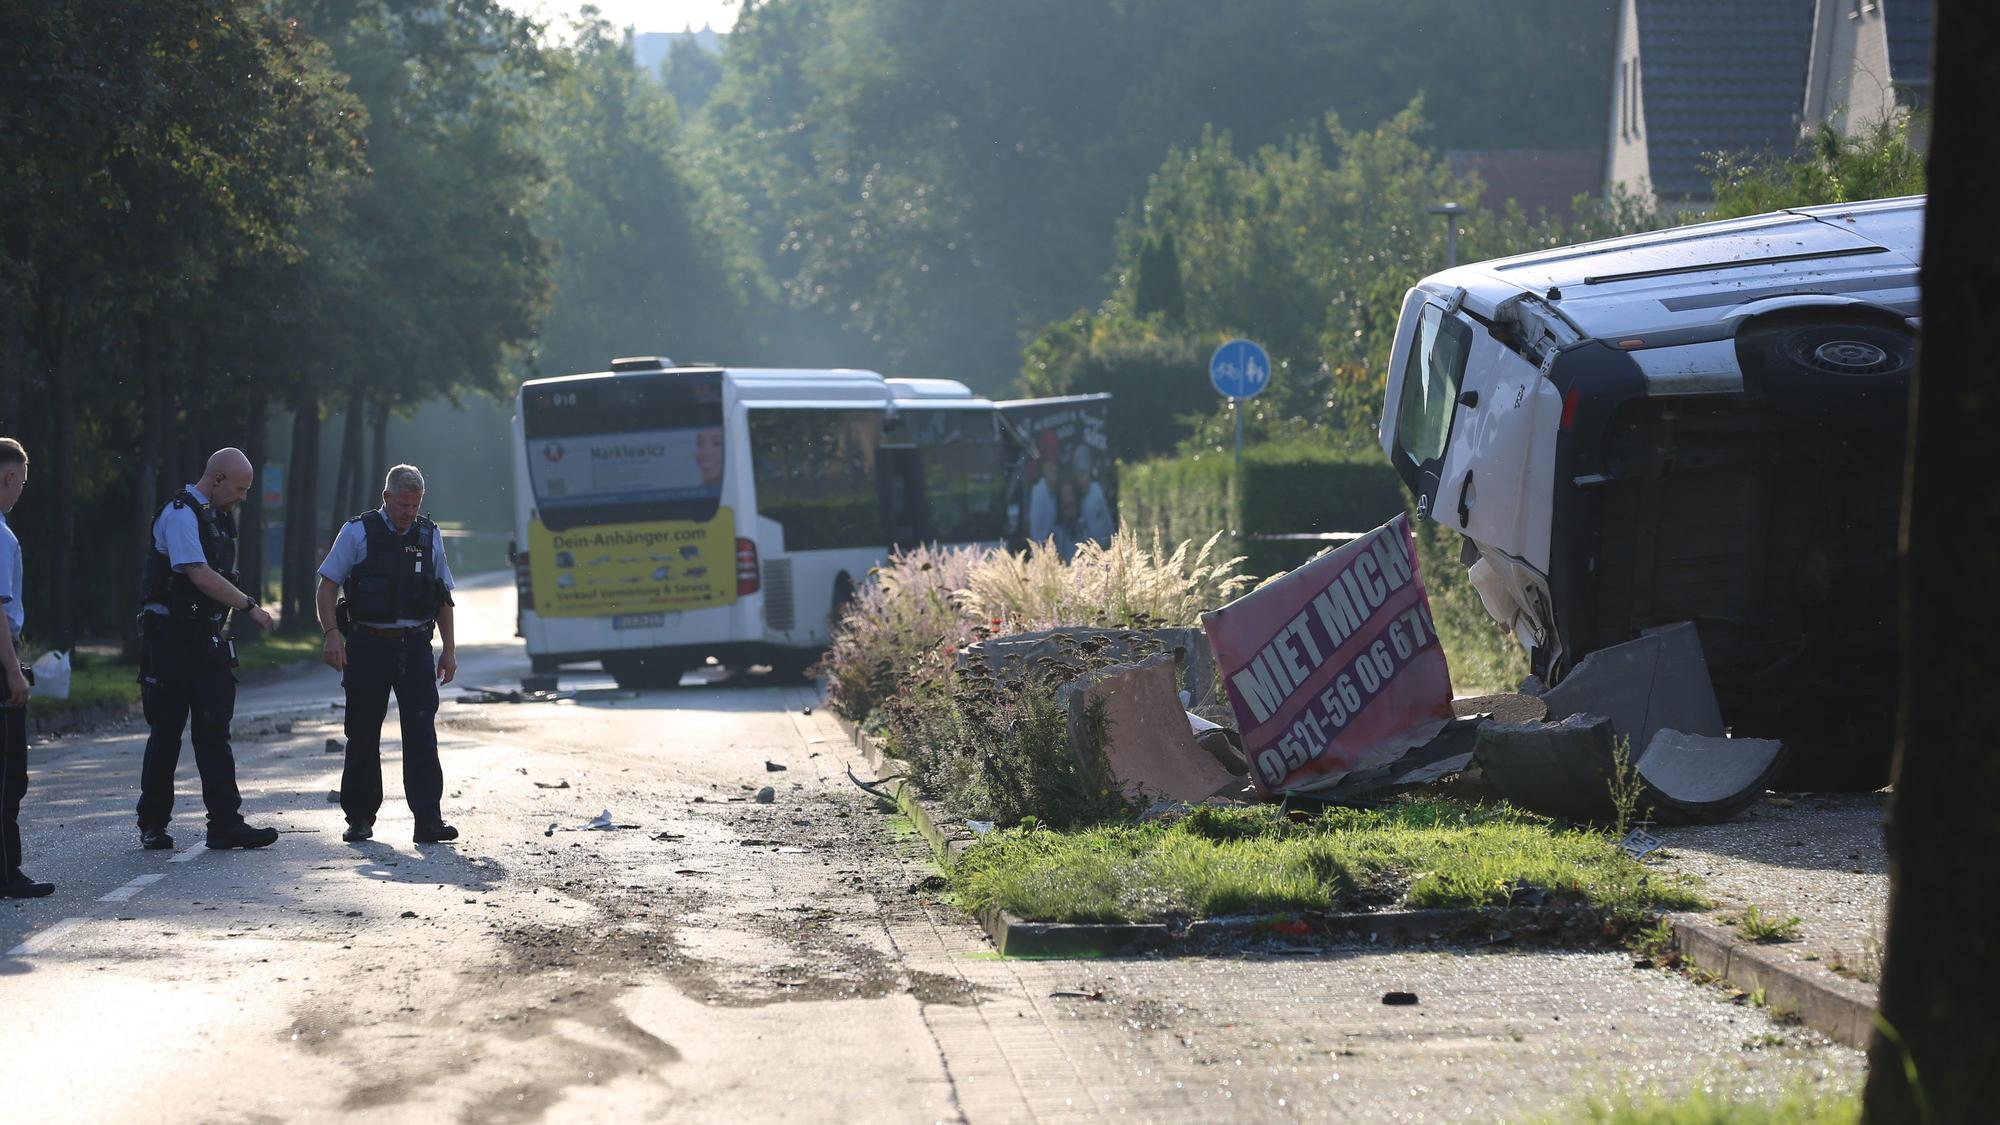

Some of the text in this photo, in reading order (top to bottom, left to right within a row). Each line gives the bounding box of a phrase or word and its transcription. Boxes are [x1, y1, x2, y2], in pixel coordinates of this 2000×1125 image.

[553, 393, 576, 406] 918
[553, 529, 706, 548] Dein-Anhänger.com
[674, 583, 711, 593] Service
[1231, 611, 1323, 724] MIET
[1257, 673, 1361, 785] 0521-56
[1354, 640, 1394, 696] 06
